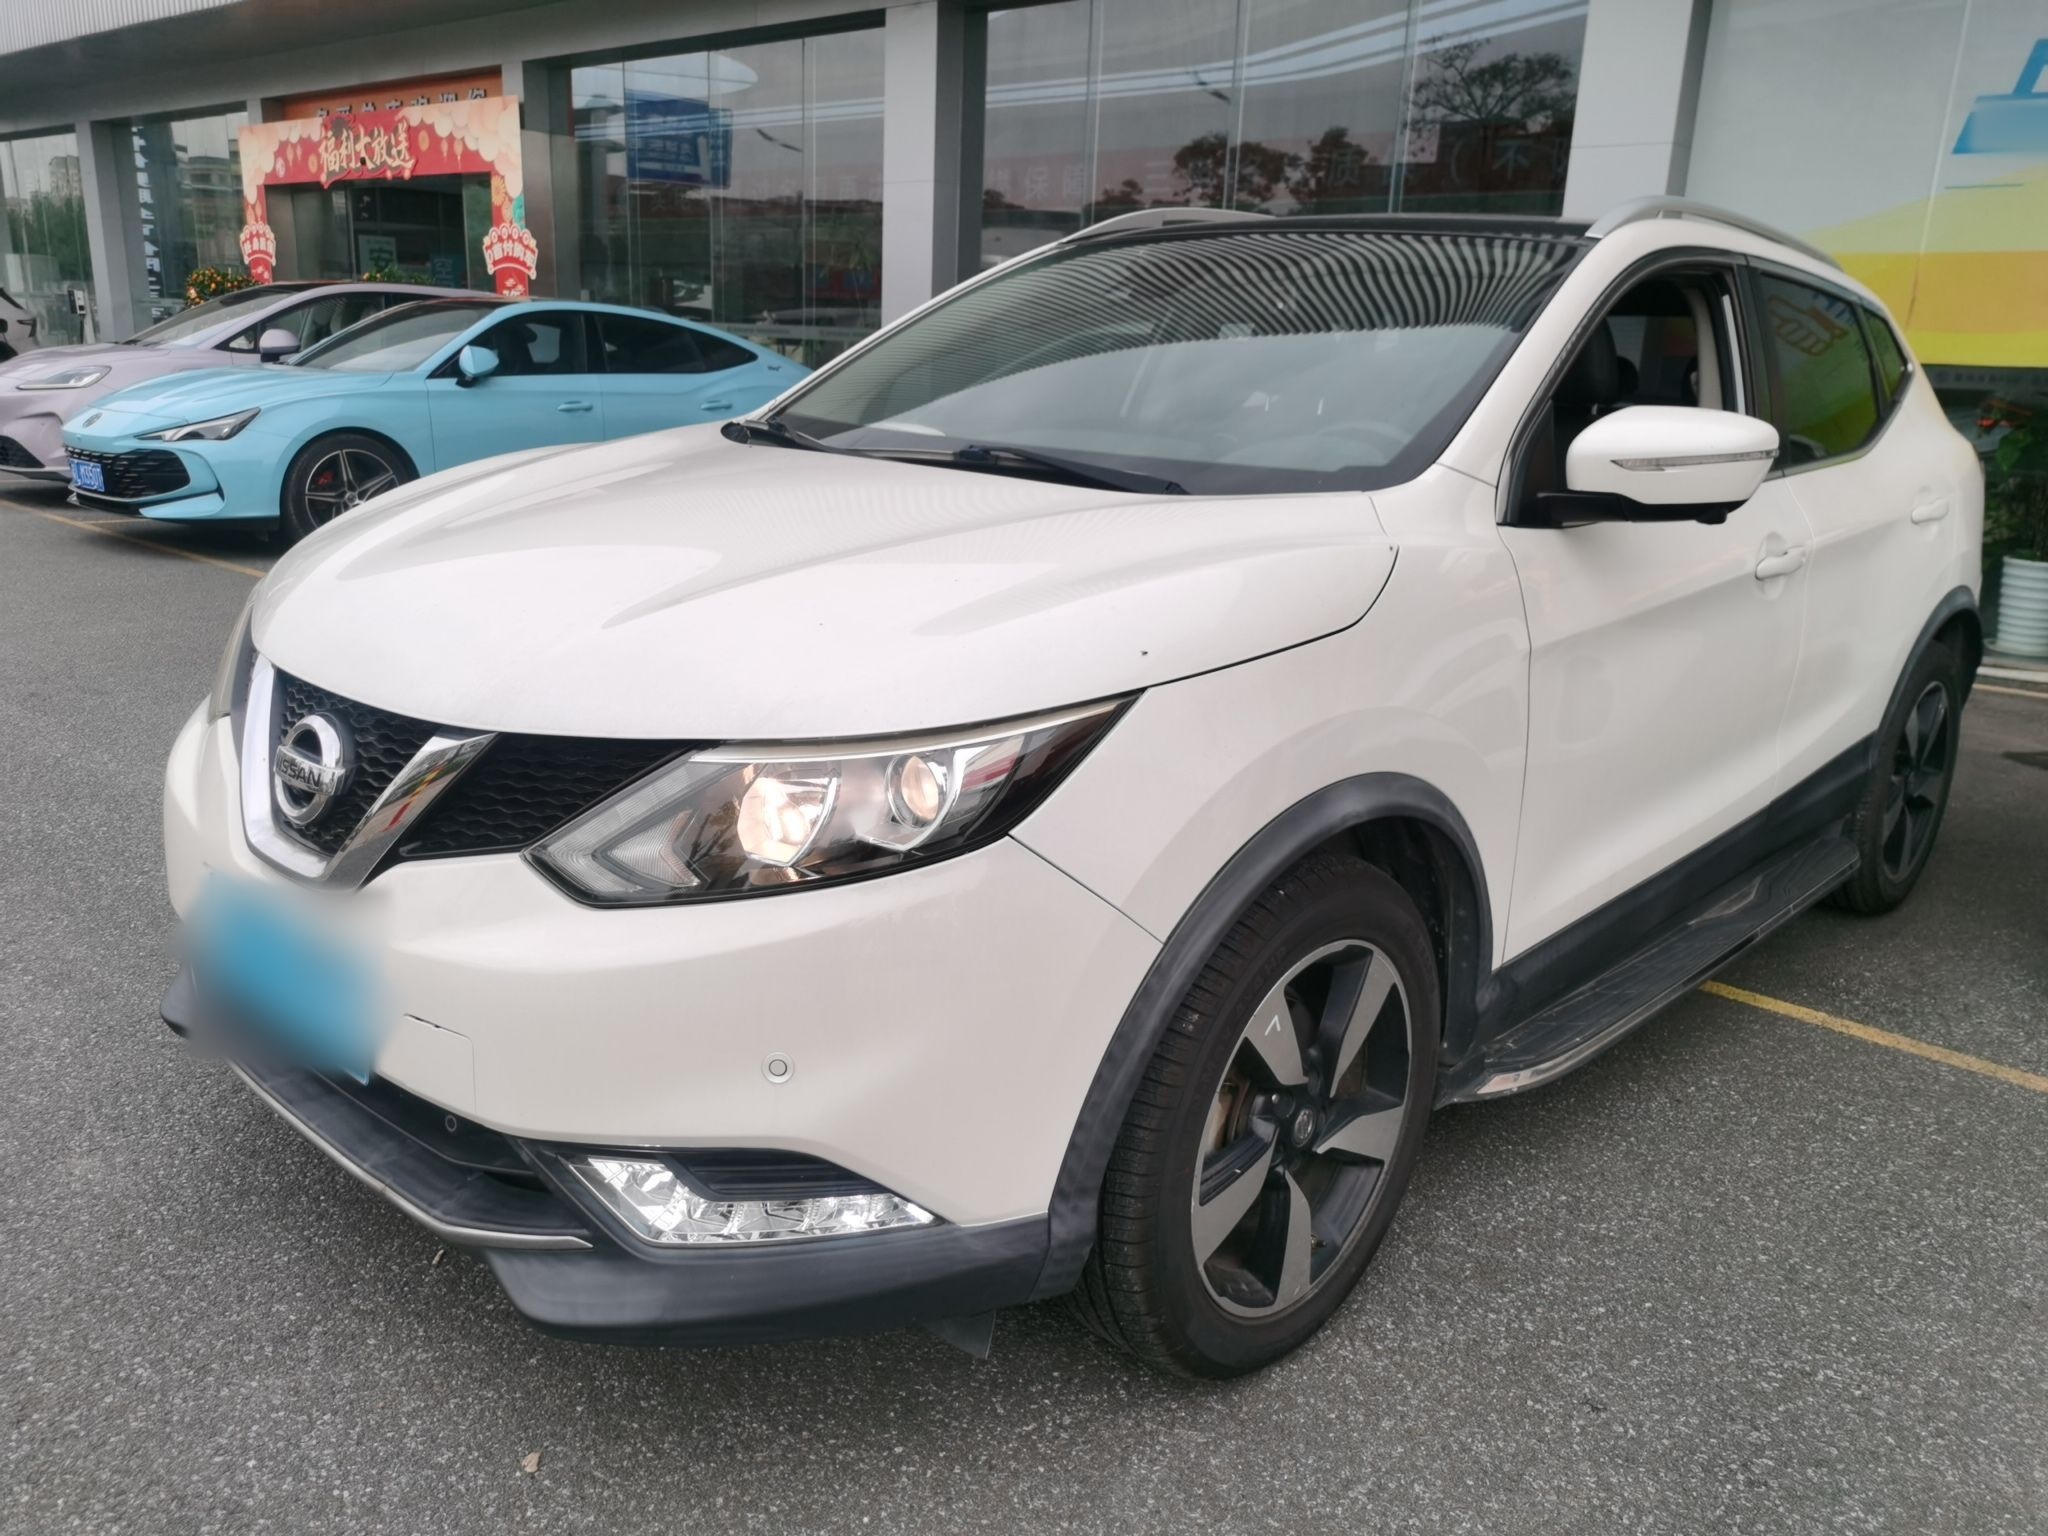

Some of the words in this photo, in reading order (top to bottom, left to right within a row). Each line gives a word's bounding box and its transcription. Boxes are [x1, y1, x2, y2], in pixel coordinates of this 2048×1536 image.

[318, 120, 415, 177] 福利大放送
